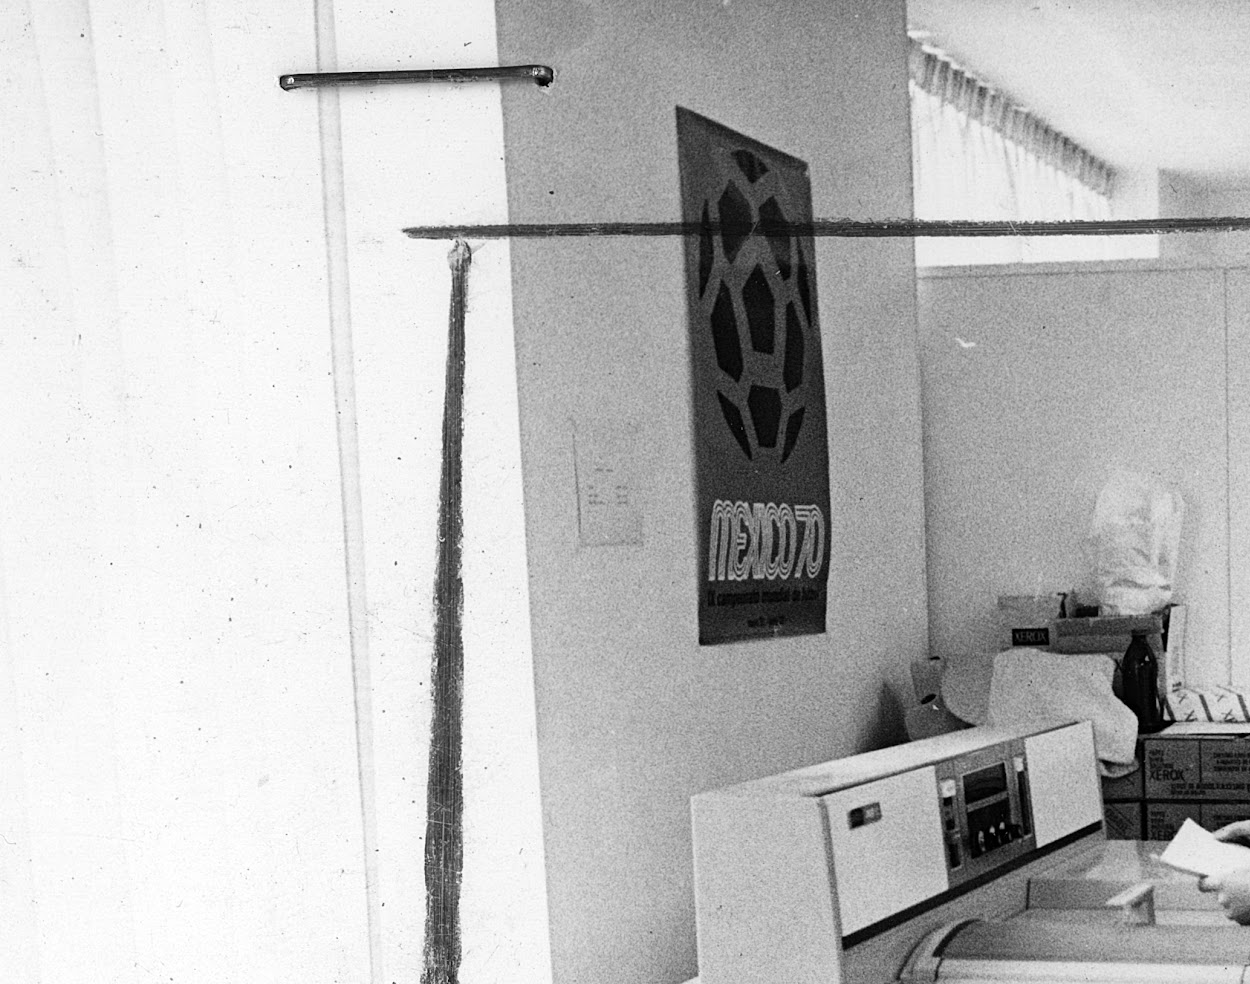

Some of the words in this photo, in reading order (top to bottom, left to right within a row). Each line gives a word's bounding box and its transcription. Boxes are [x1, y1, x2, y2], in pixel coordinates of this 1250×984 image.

[708, 499, 797, 581] MEXICO
[794, 504, 825, 578] 70
[1013, 630, 1048, 643] XEROX
[1149, 769, 1185, 782] XEROX
